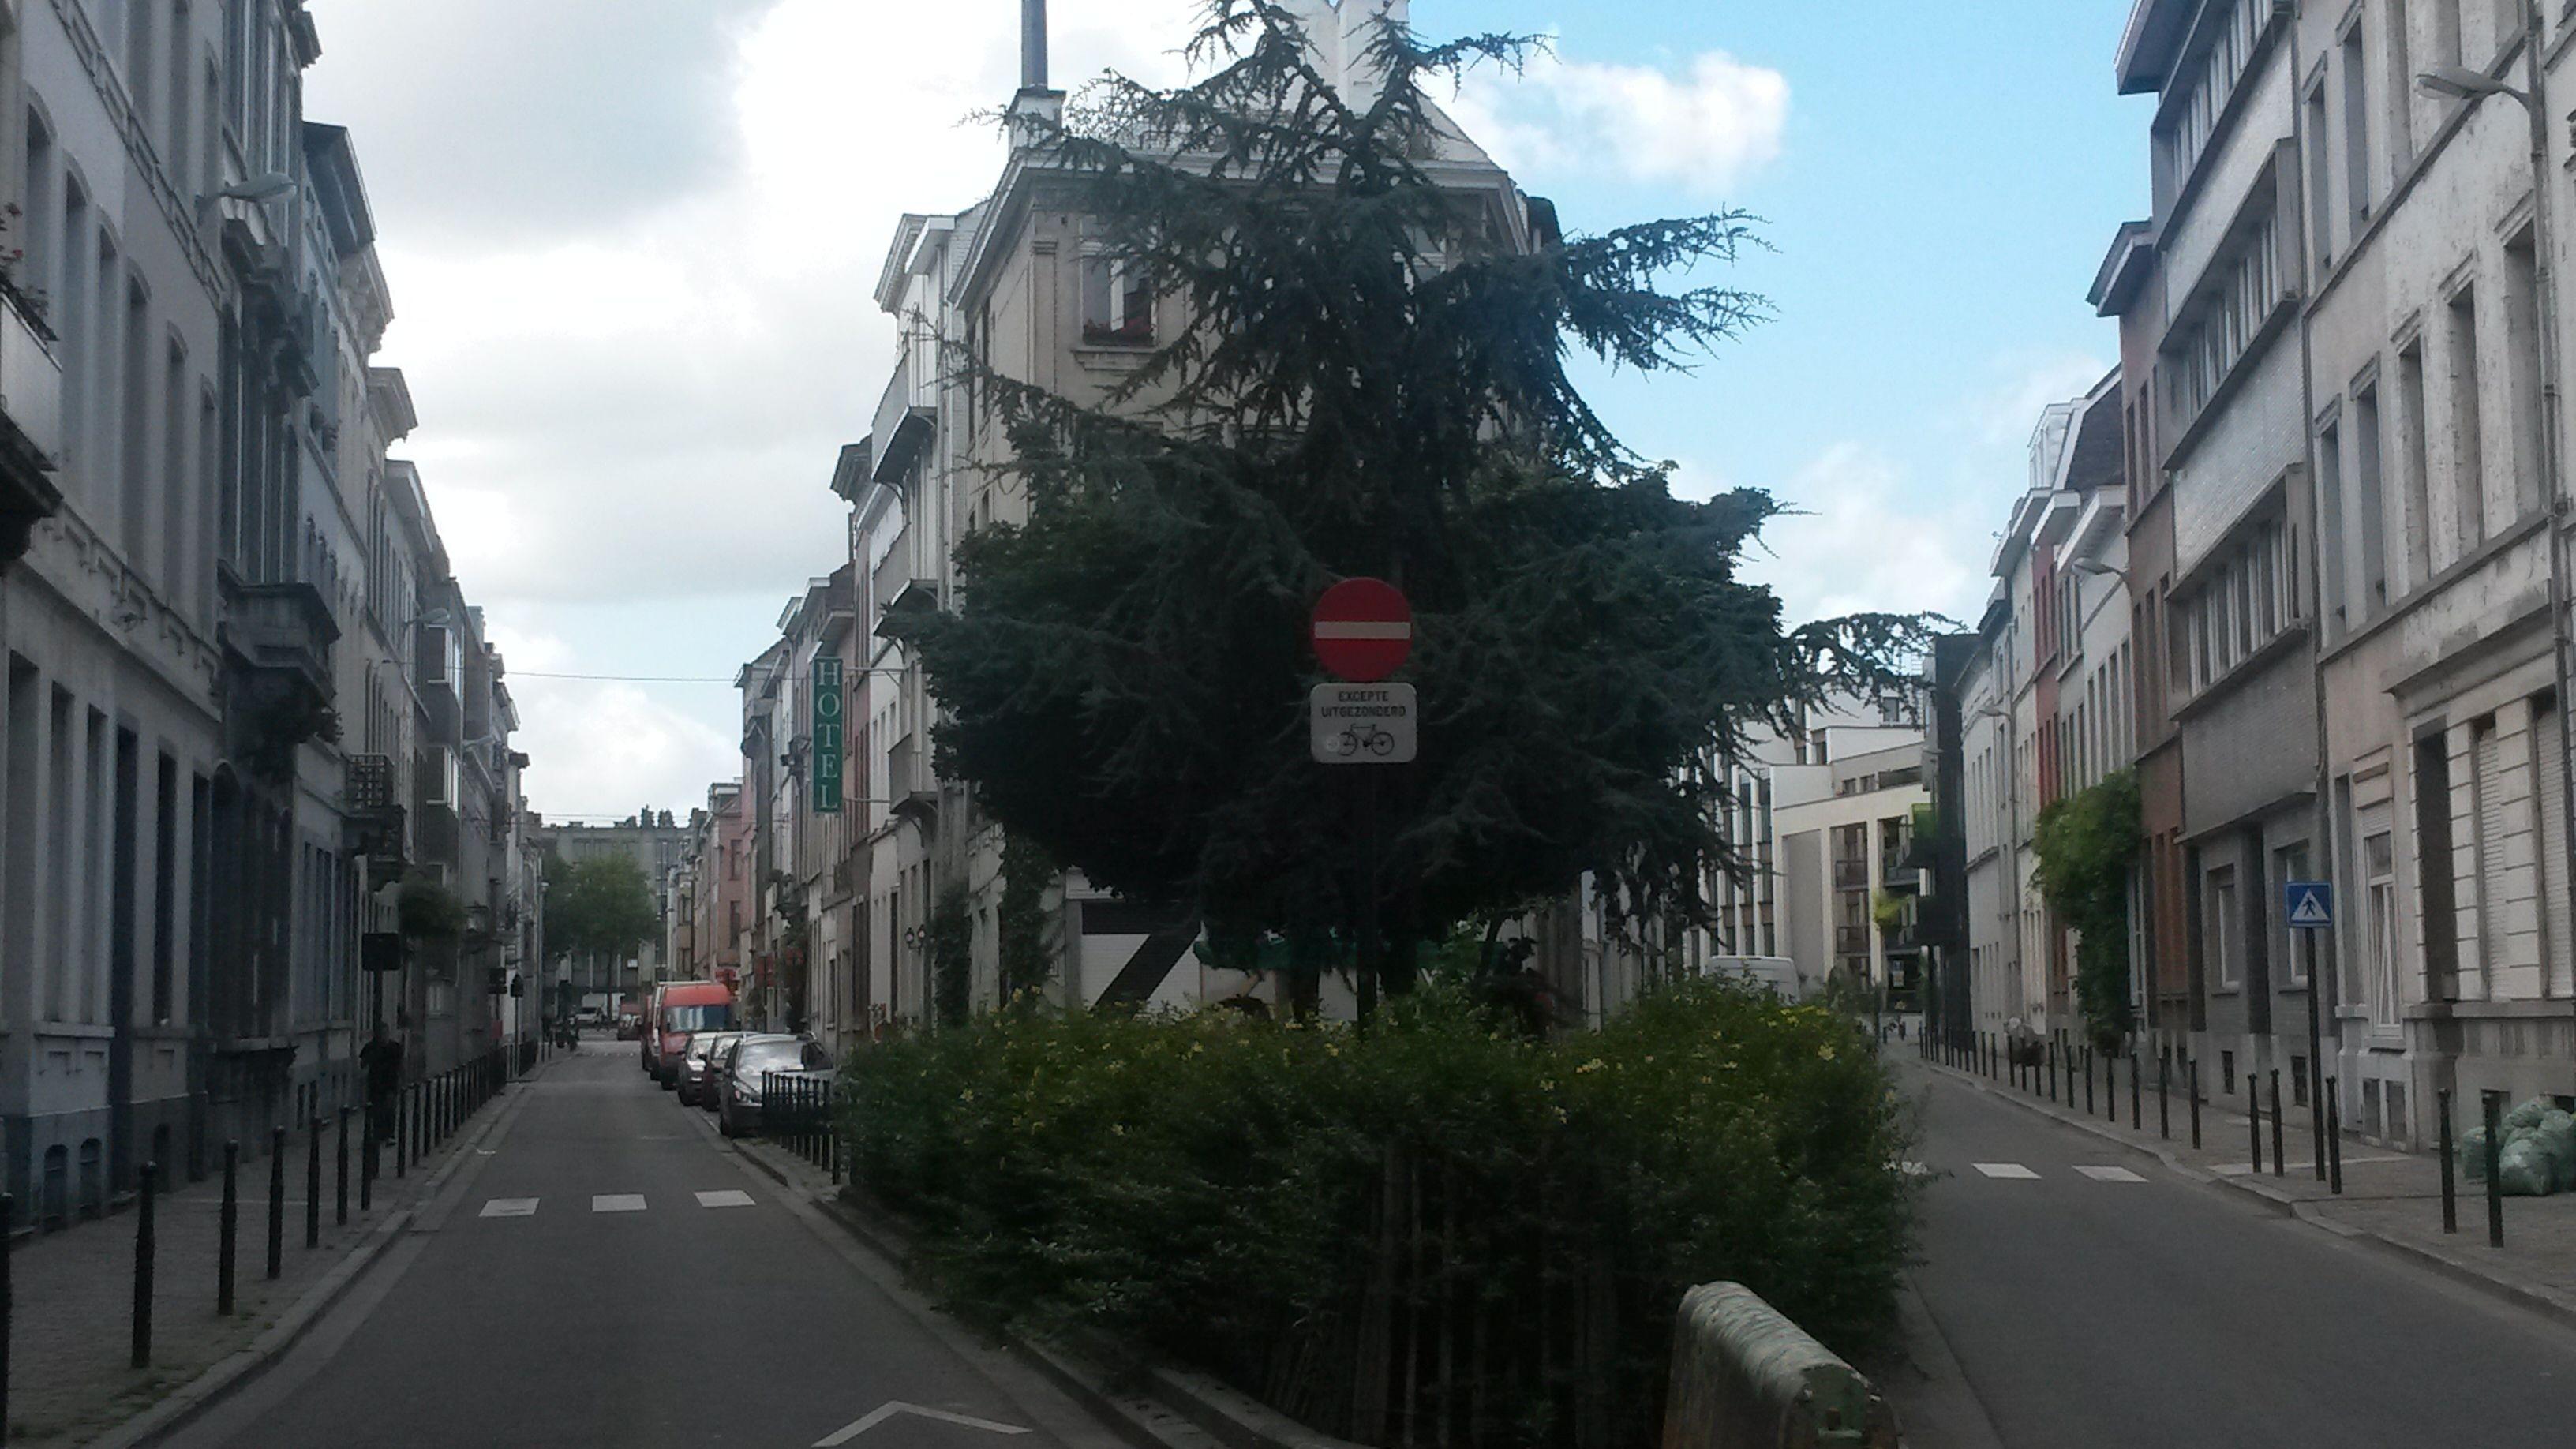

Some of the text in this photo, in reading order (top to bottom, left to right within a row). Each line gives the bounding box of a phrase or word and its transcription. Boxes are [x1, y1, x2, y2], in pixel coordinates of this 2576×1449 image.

[1338, 691, 1389, 702] EXCEPTE
[1321, 706, 1406, 717] UITGEZONDERD
[817, 661, 841, 809] HOTEL
